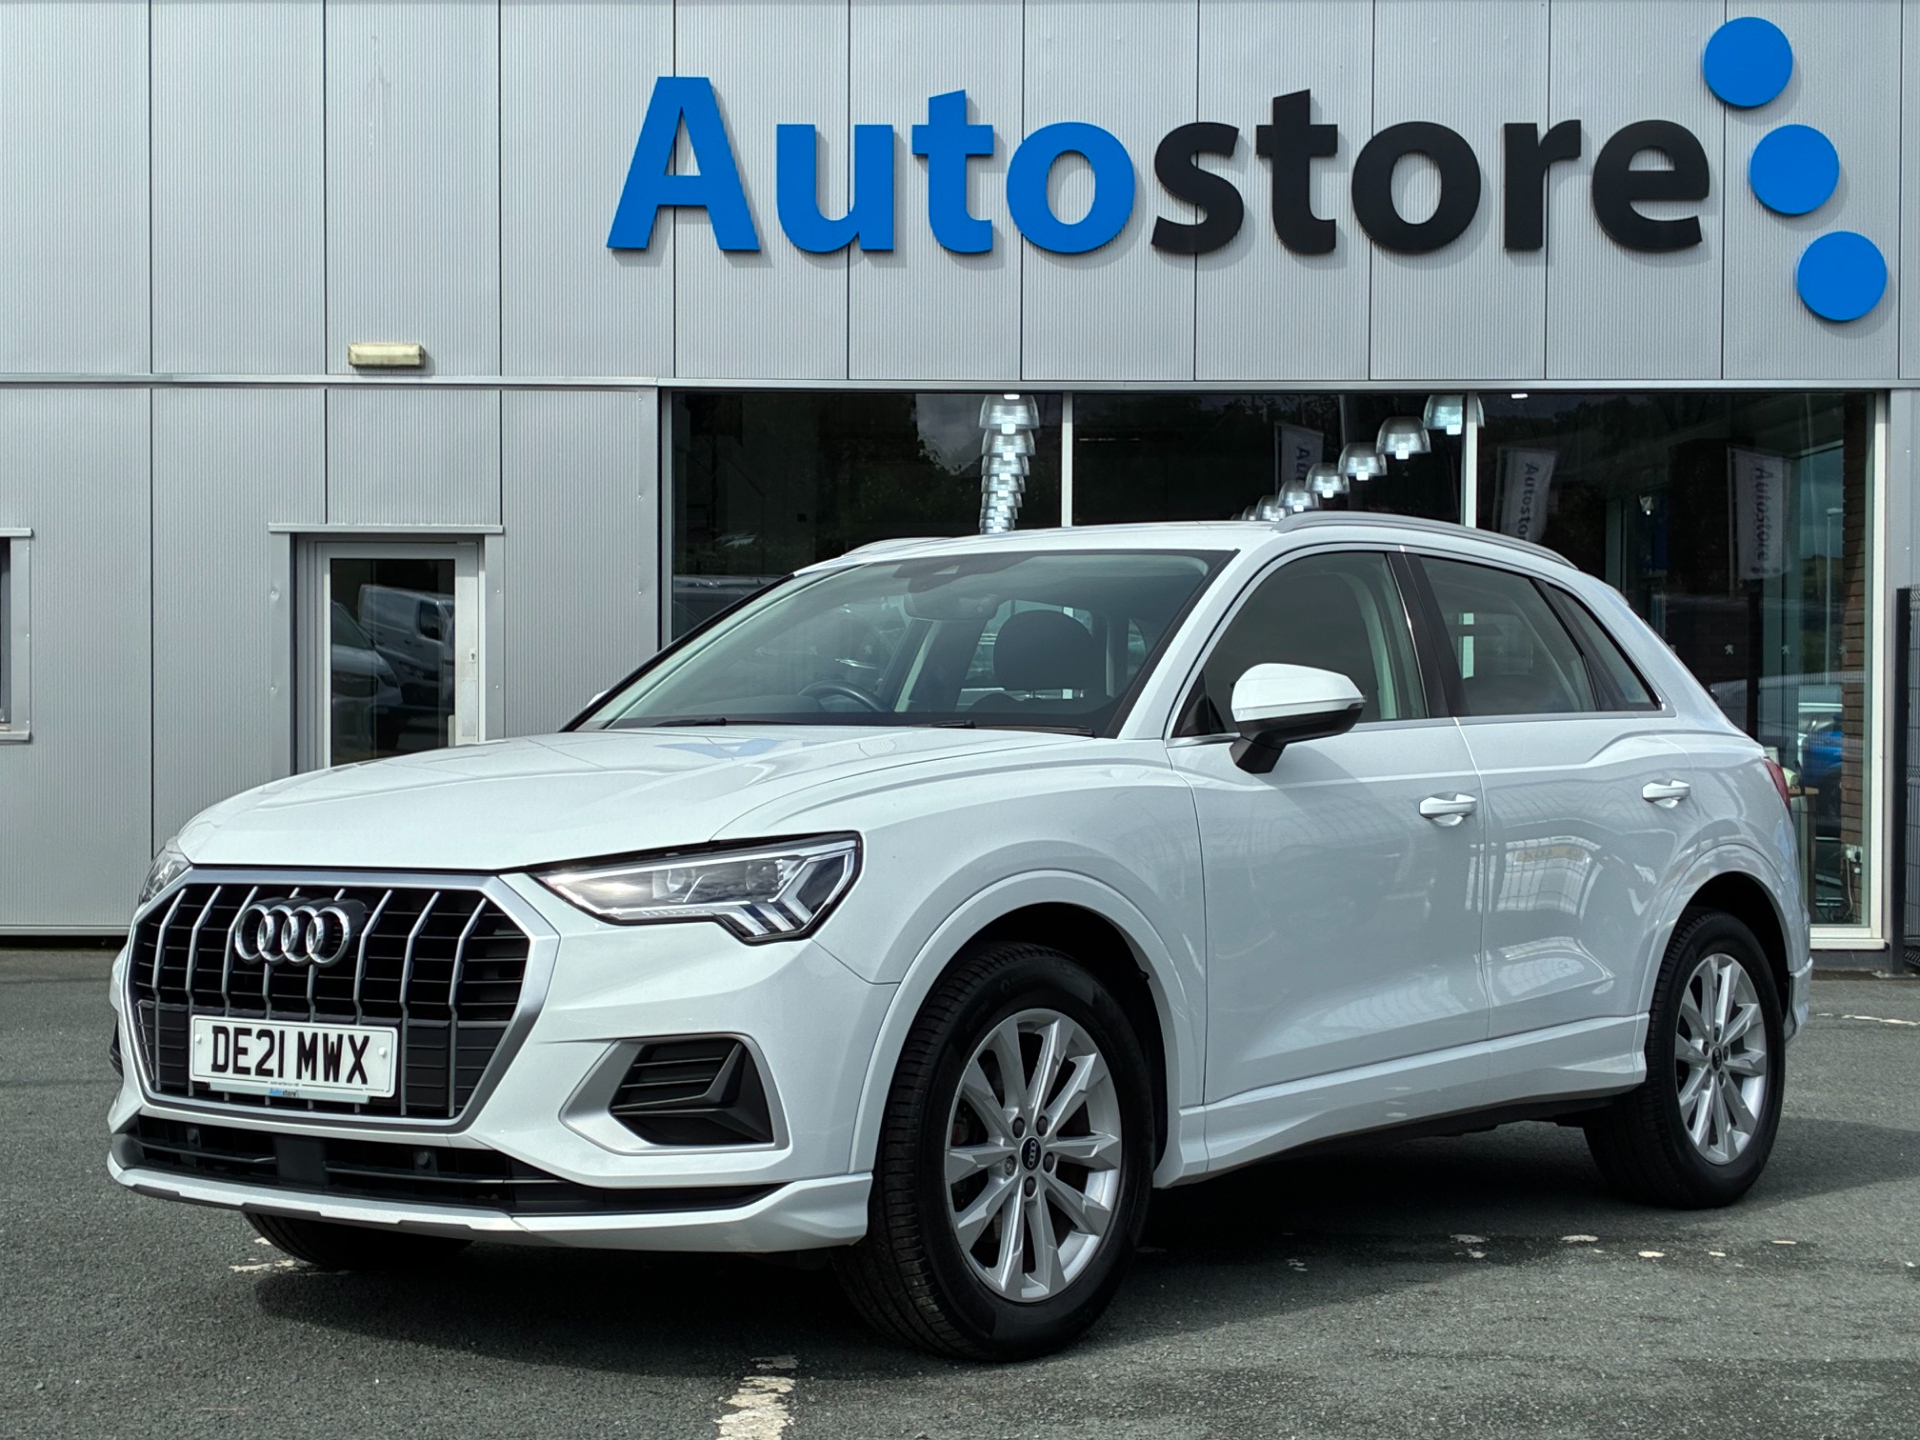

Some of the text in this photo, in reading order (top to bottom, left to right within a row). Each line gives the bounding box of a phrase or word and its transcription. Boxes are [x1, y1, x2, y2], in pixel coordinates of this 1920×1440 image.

[607, 77, 1709, 254] Autostore
[1755, 467, 1774, 561] Autostore
[211, 1025, 370, 1084] DE21 MWX
